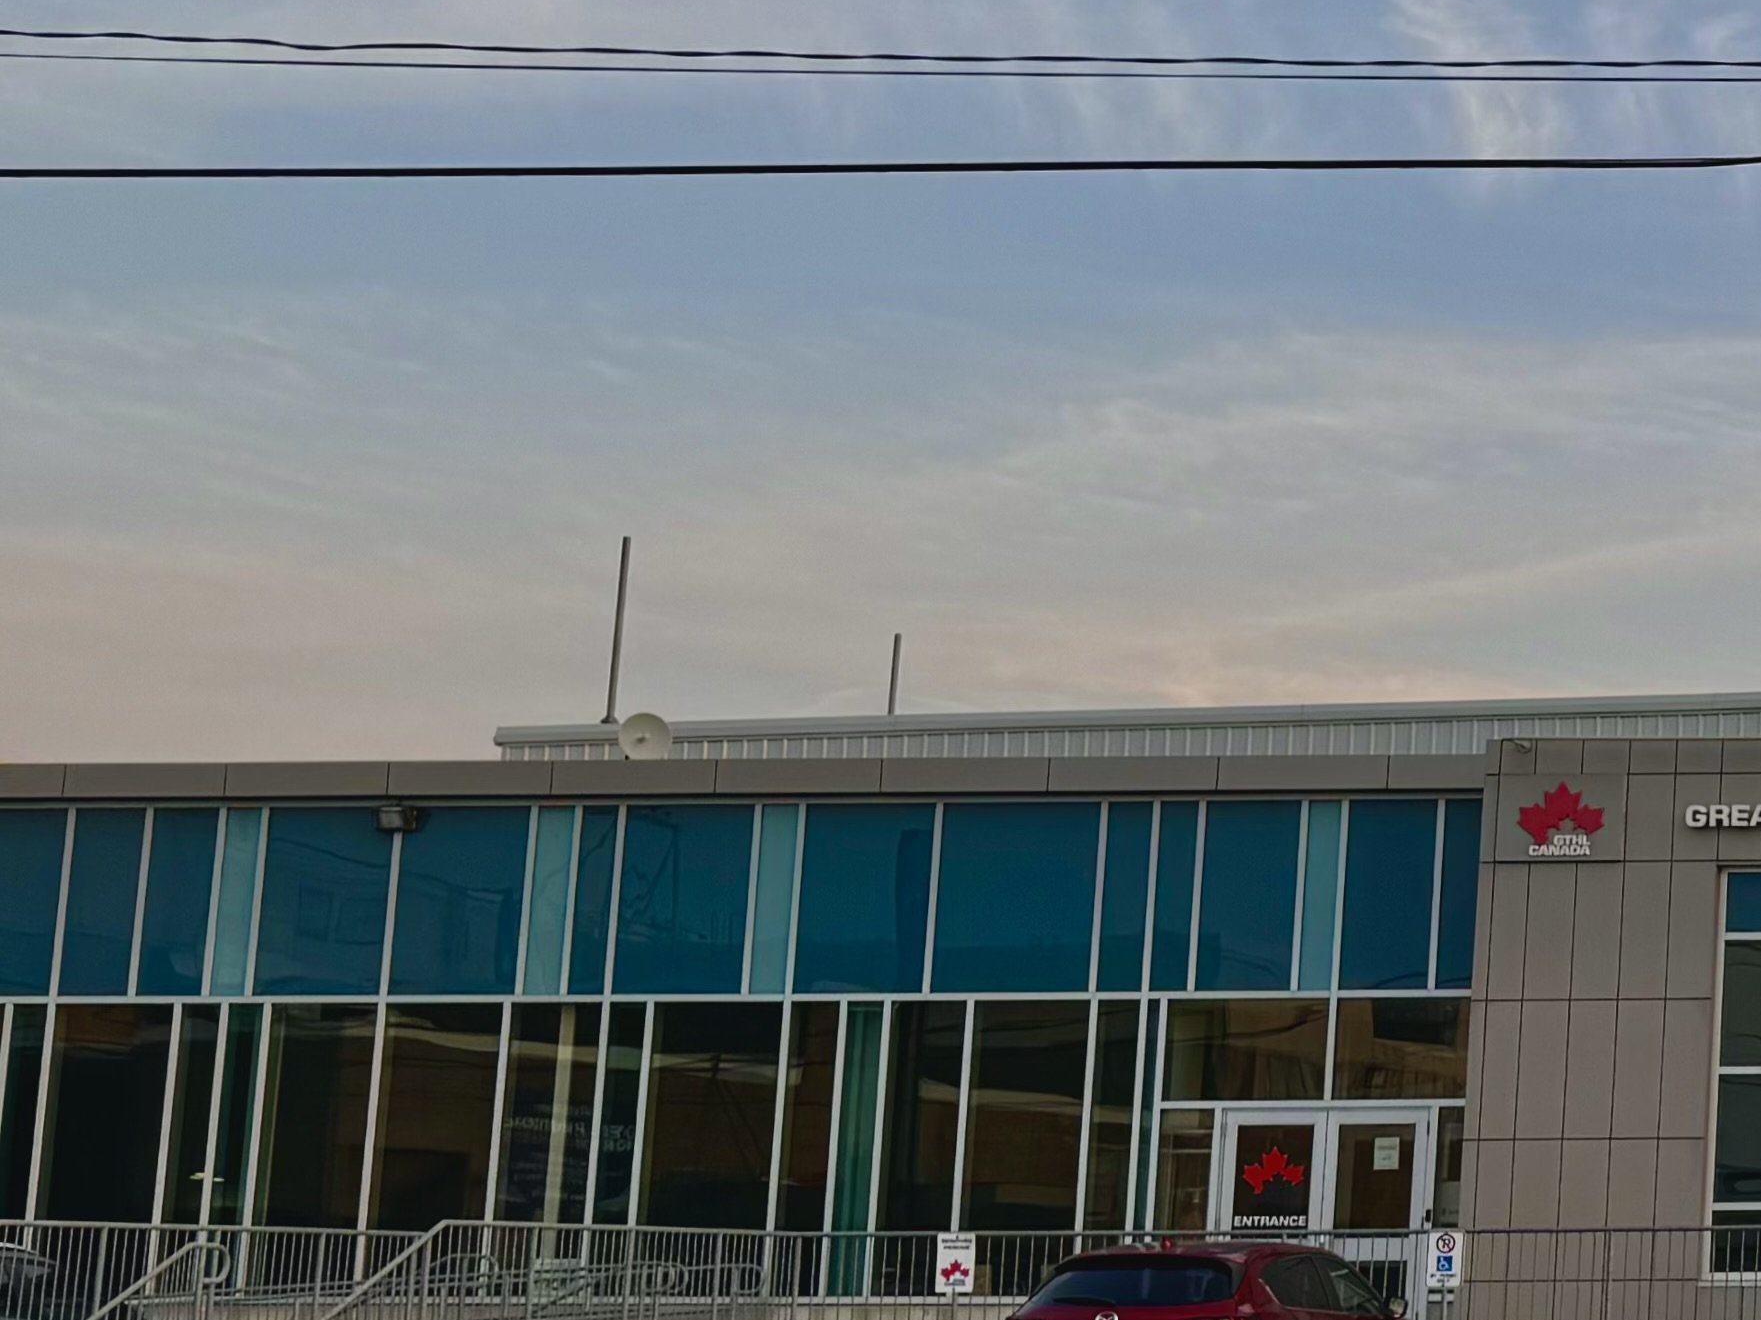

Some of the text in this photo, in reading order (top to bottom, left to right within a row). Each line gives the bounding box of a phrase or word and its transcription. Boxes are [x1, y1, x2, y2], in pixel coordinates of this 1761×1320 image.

[1553, 834, 1591, 846] GTHL
[1528, 844, 1591, 856] CANADA
[1233, 1215, 1308, 1227] ENTRANCE
